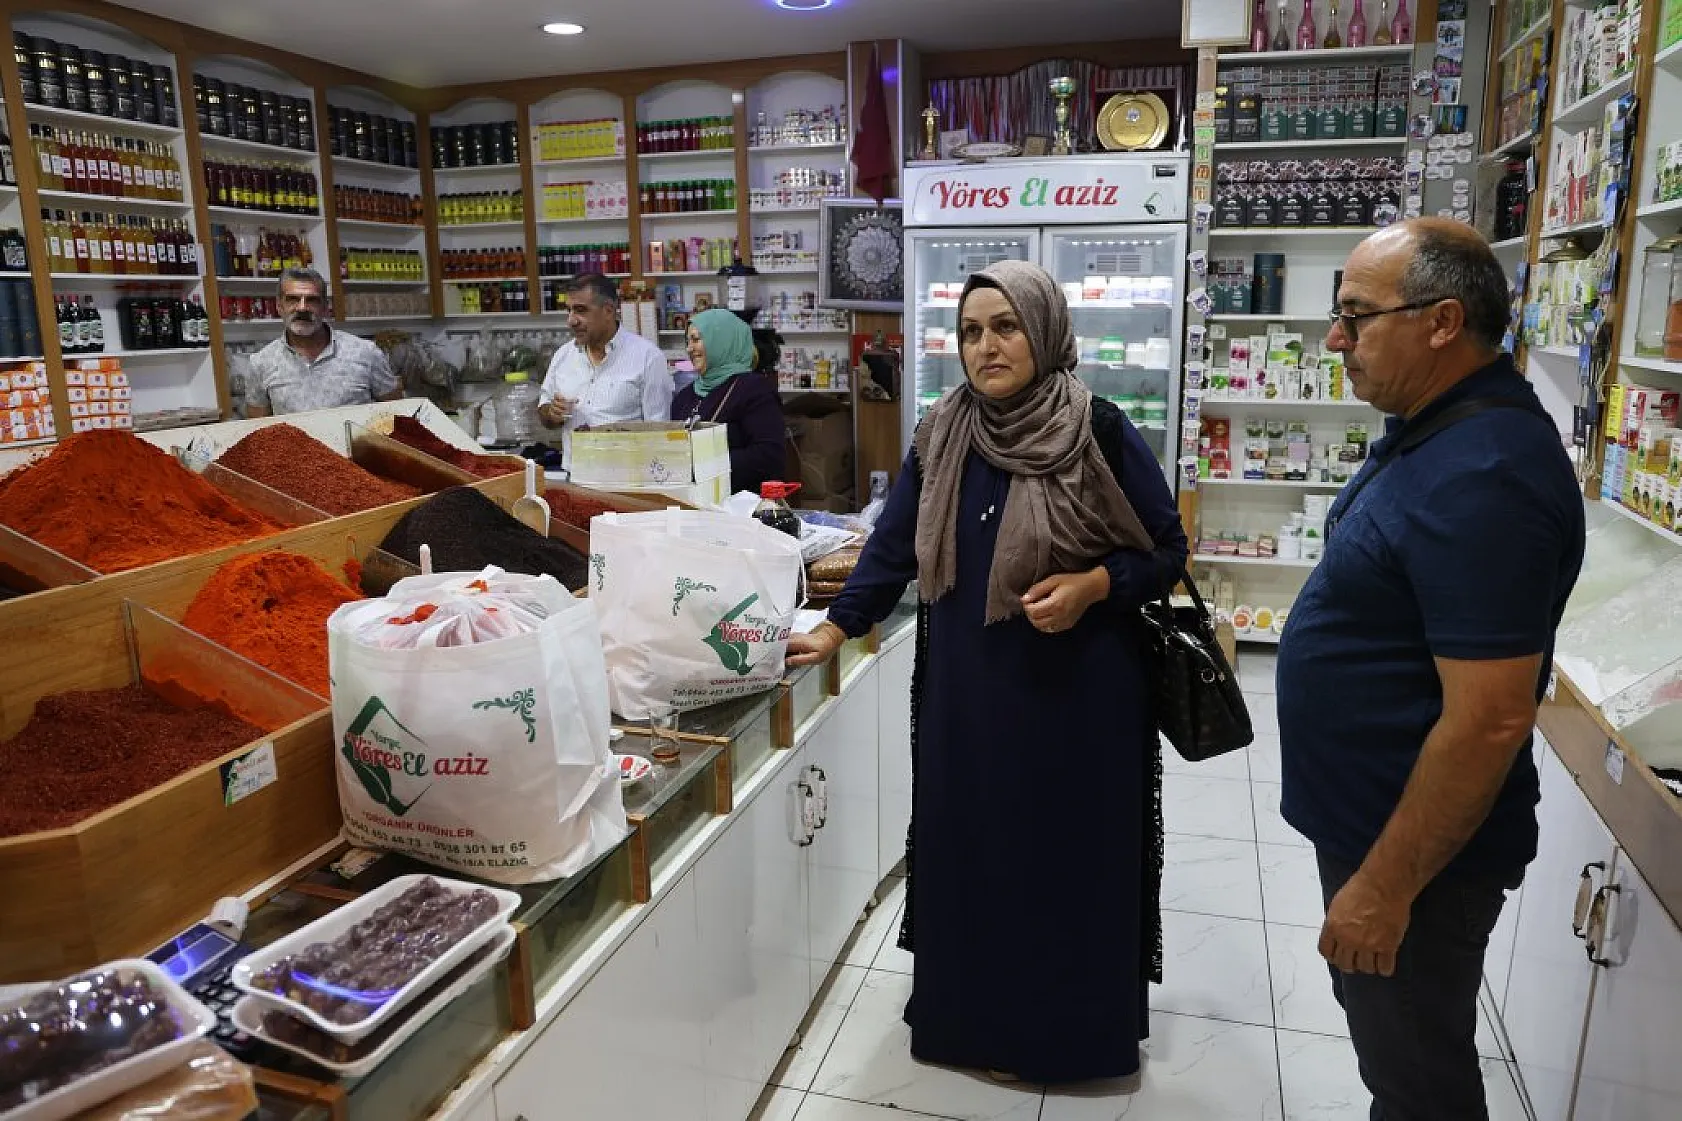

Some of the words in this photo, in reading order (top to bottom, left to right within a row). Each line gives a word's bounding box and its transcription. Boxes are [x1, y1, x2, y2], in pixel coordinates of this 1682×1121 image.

[930, 179, 1012, 209] Yöres
[1019, 177, 1048, 206] El
[1055, 177, 1119, 206] aziz
[717, 620, 762, 642] Yöres
[346, 732, 402, 771] Yöres
[403, 752, 429, 777] El
[433, 752, 490, 775] aziz
